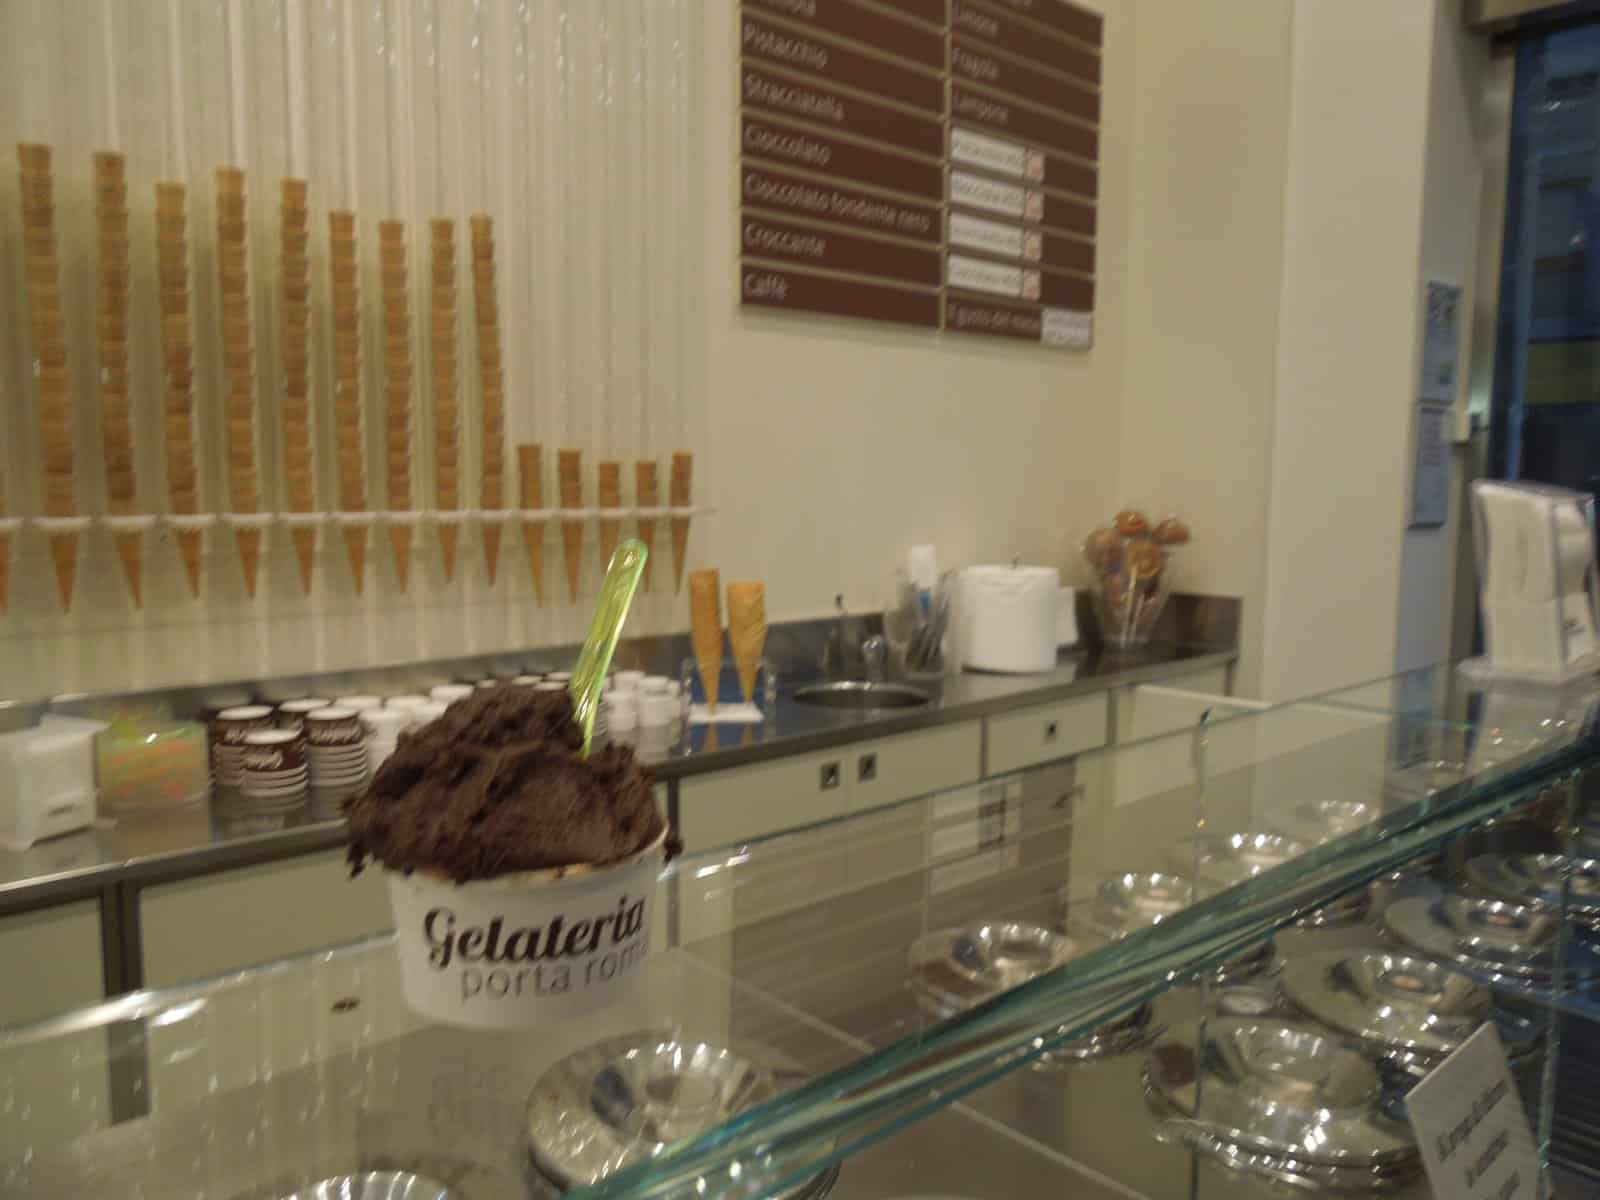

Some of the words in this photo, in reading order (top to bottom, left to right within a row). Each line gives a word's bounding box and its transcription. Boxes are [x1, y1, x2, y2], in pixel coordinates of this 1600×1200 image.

[742, 23, 828, 70] Pistacchio
[742, 73, 845, 122] Stracciatella
[742, 124, 831, 167] Cioccolato
[743, 173, 830, 212] Cioccolato
[743, 223, 827, 258] Croccante
[424, 895, 647, 969] Gelateria
[461, 964, 571, 1003] porta
